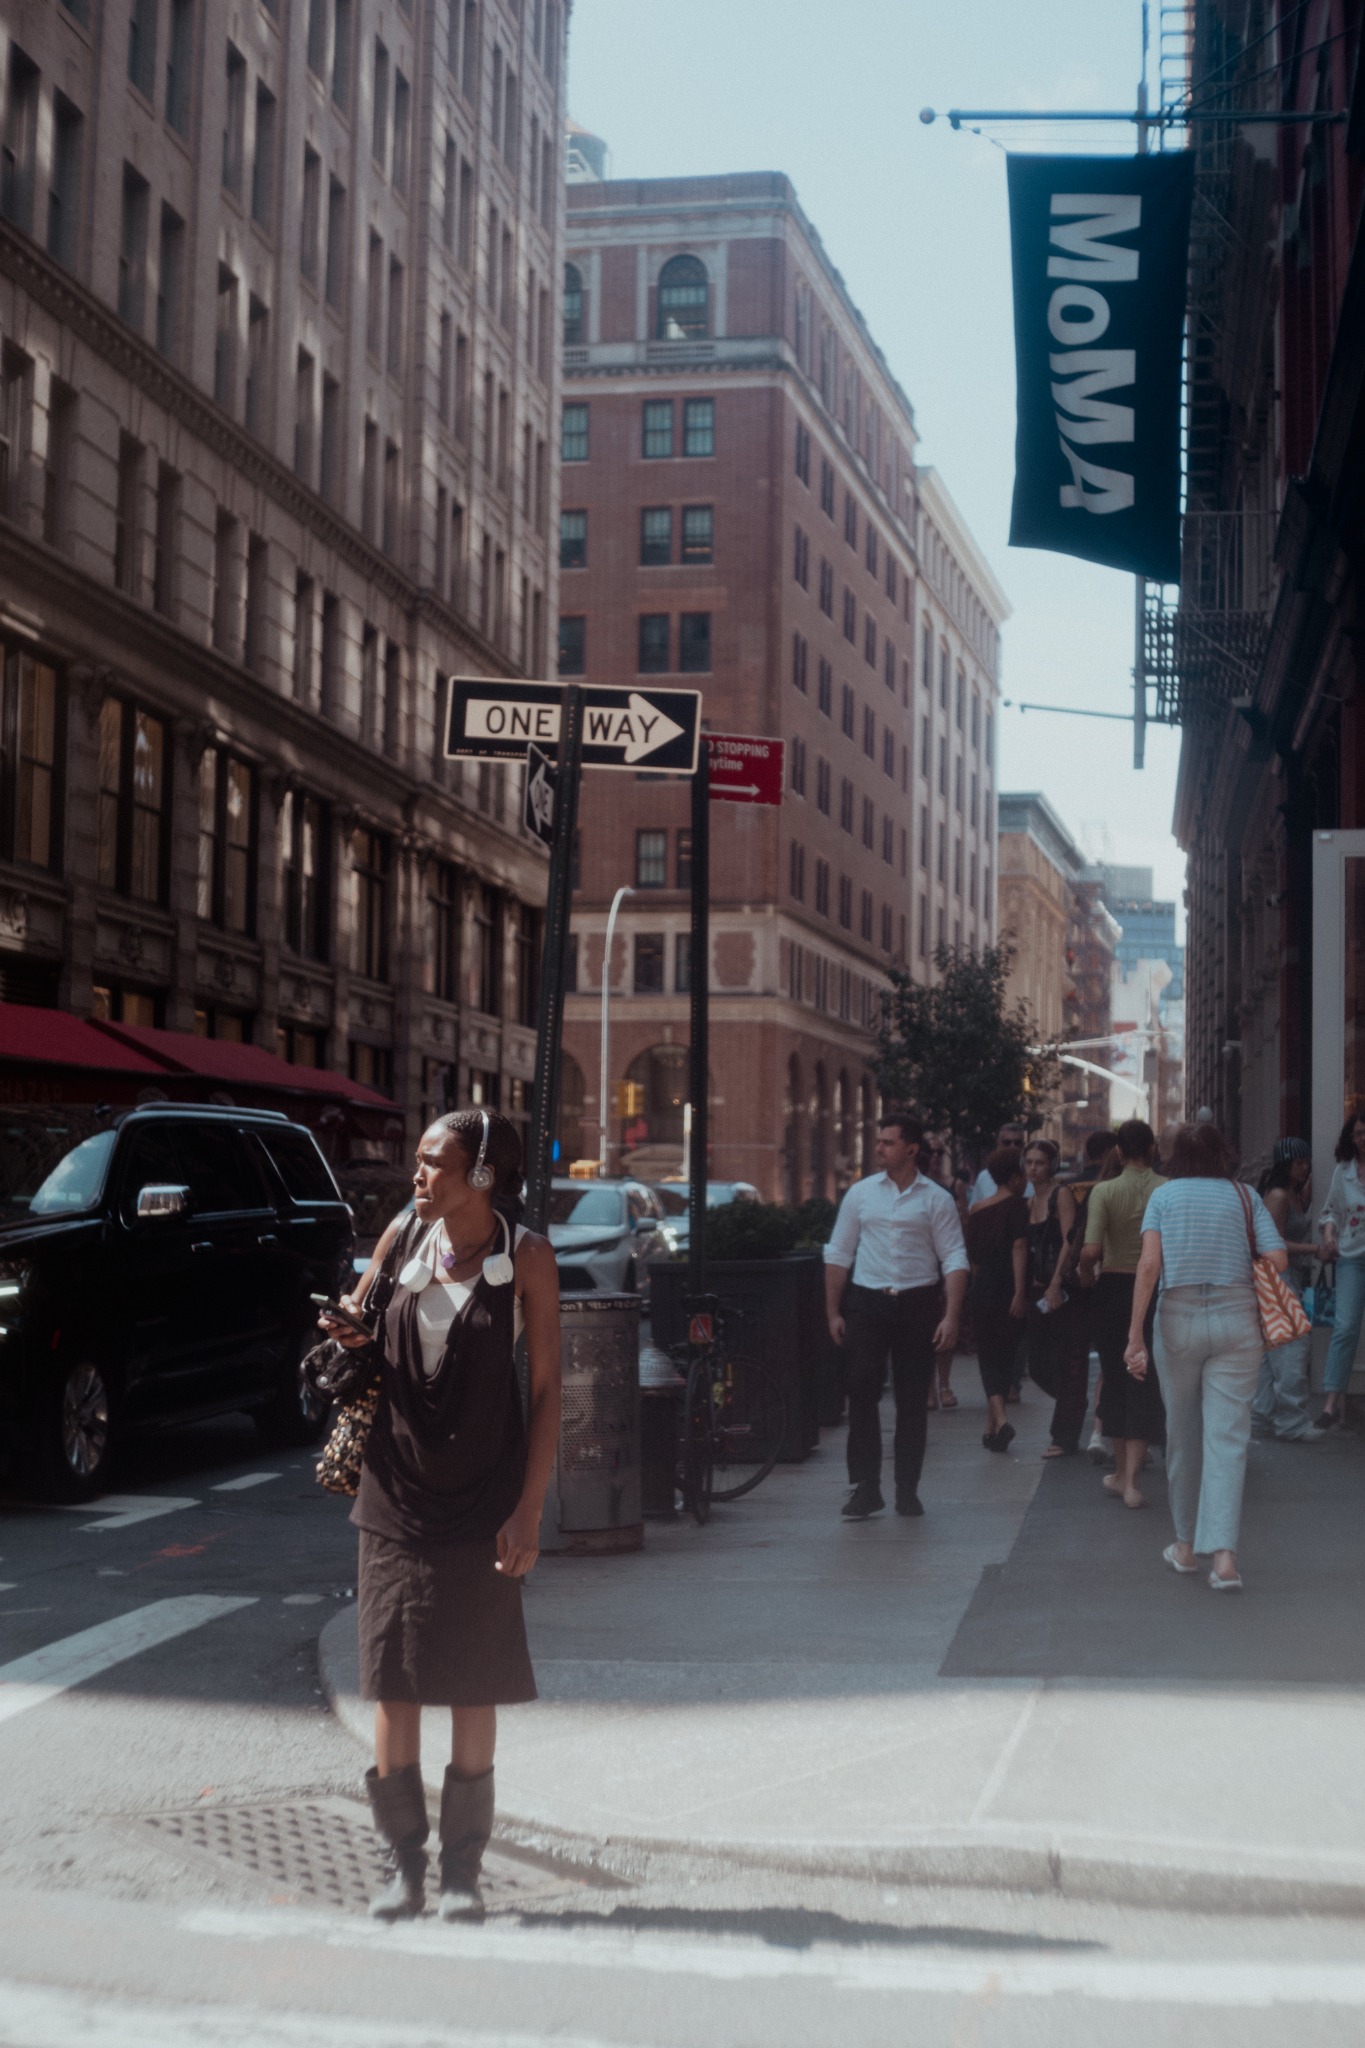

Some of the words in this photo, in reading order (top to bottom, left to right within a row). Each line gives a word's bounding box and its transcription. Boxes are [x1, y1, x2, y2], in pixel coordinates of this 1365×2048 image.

[1047, 193, 1142, 514] MoMA
[486, 705, 553, 737] ONE
[588, 711, 660, 744] WAY
[717, 741, 770, 758] STOPPING
